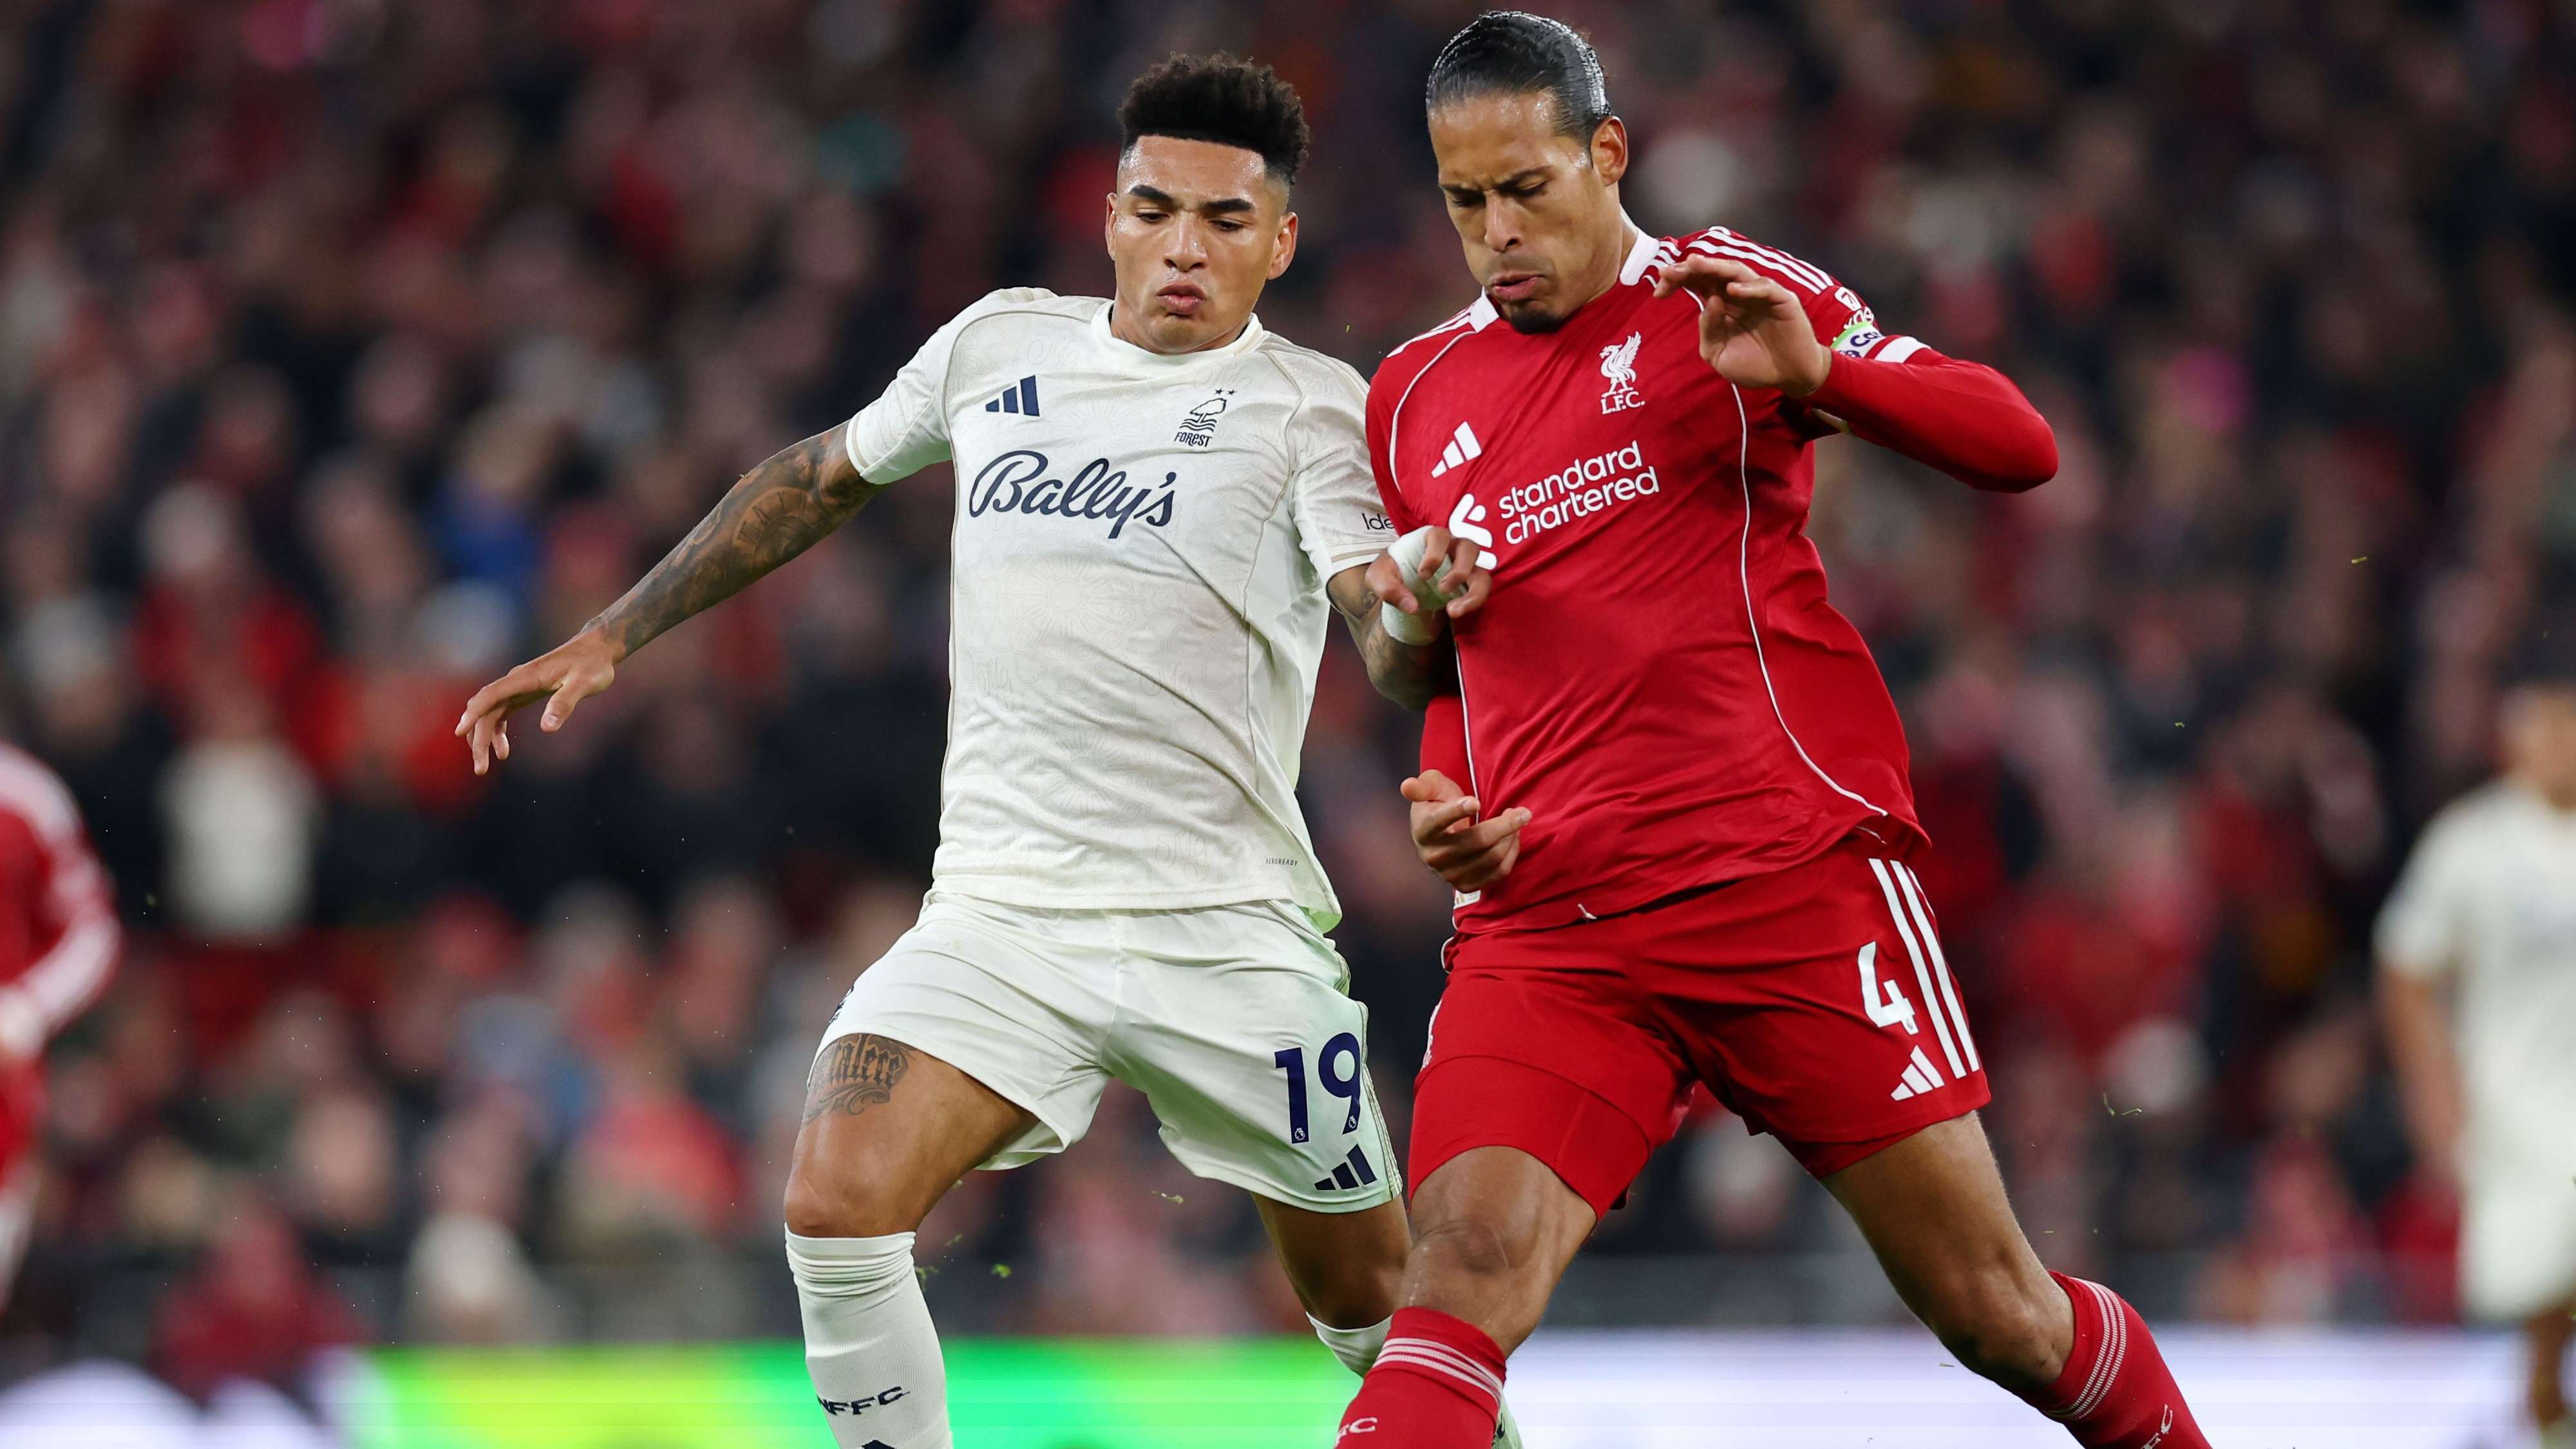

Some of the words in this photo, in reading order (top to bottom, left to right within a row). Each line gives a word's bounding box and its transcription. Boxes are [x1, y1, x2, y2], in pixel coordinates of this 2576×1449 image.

[969, 450, 1177, 539] Bally's
[1498, 440, 1643, 519] standard
[1505, 466, 1660, 545] chartered
[1857, 940, 1919, 1036] 4
[1274, 1032, 1361, 1144] 19
